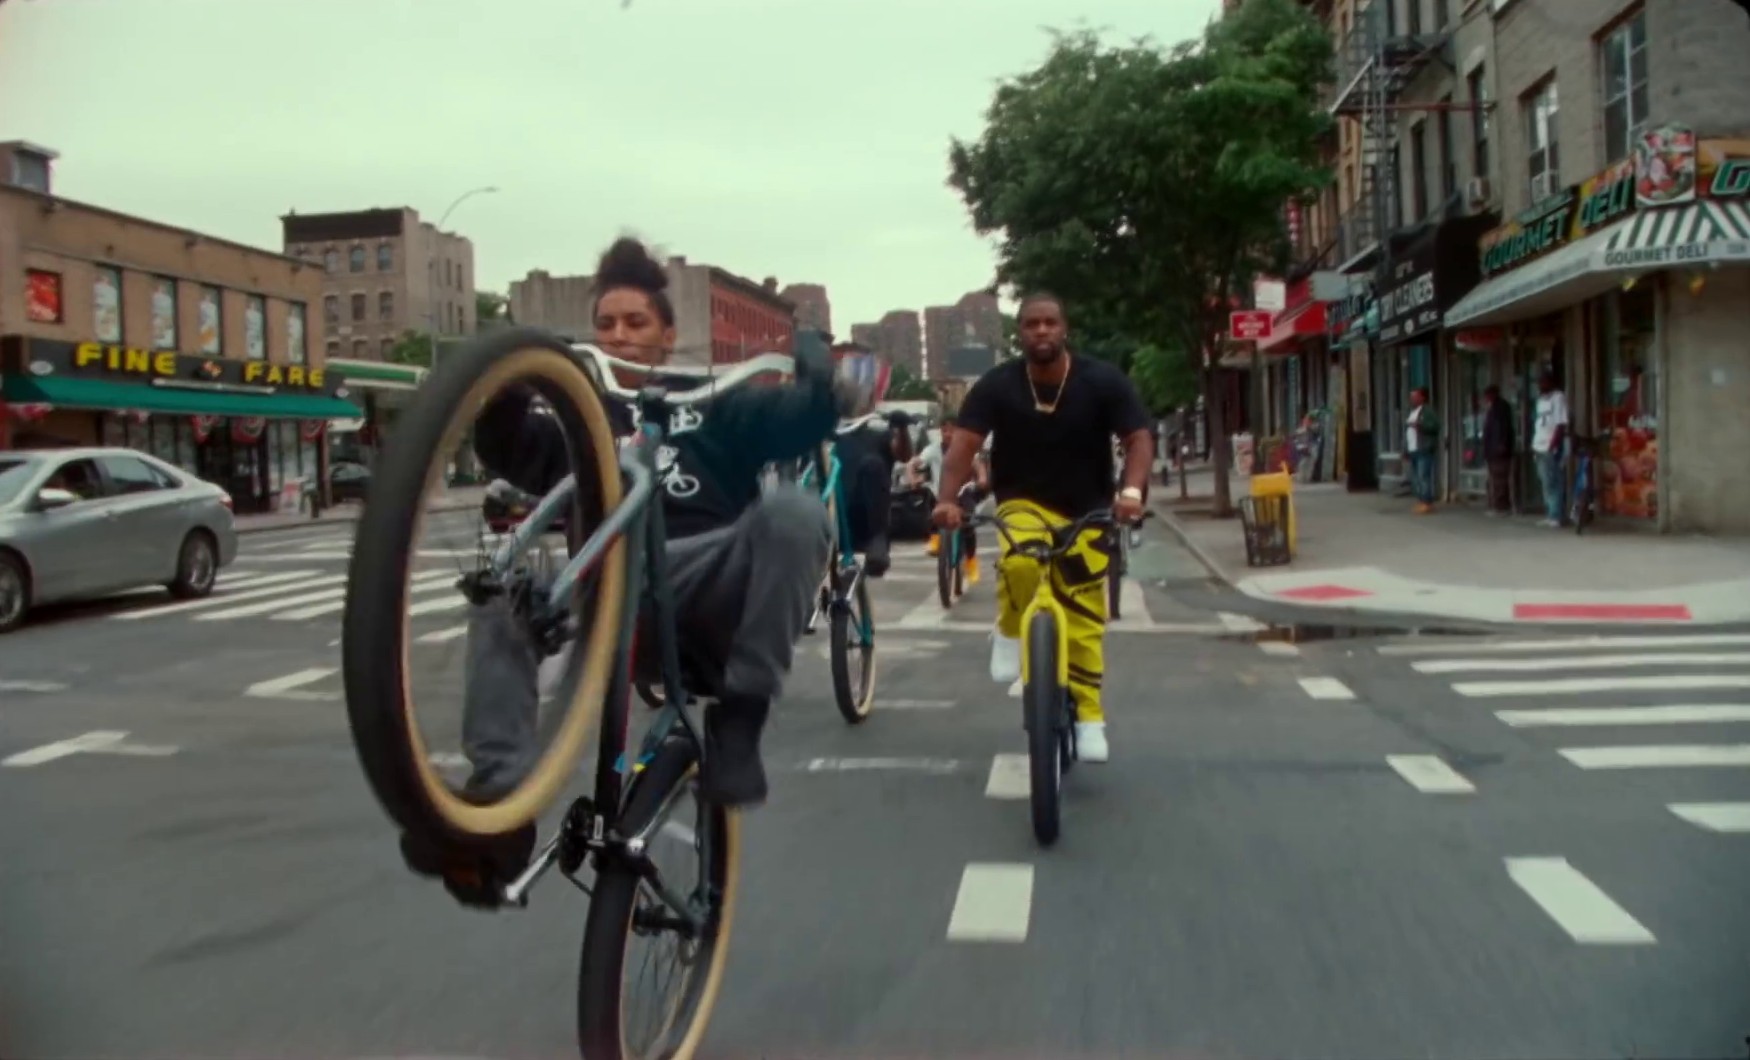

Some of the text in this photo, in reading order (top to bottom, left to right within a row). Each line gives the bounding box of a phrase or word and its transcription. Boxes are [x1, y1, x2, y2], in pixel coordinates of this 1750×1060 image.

[1484, 206, 1570, 271] GOURMET
[1582, 175, 1634, 228] DELI
[1605, 246, 1671, 266] GOURMET
[1677, 242, 1709, 260] DELI
[75, 342, 324, 387] FINE FARE
